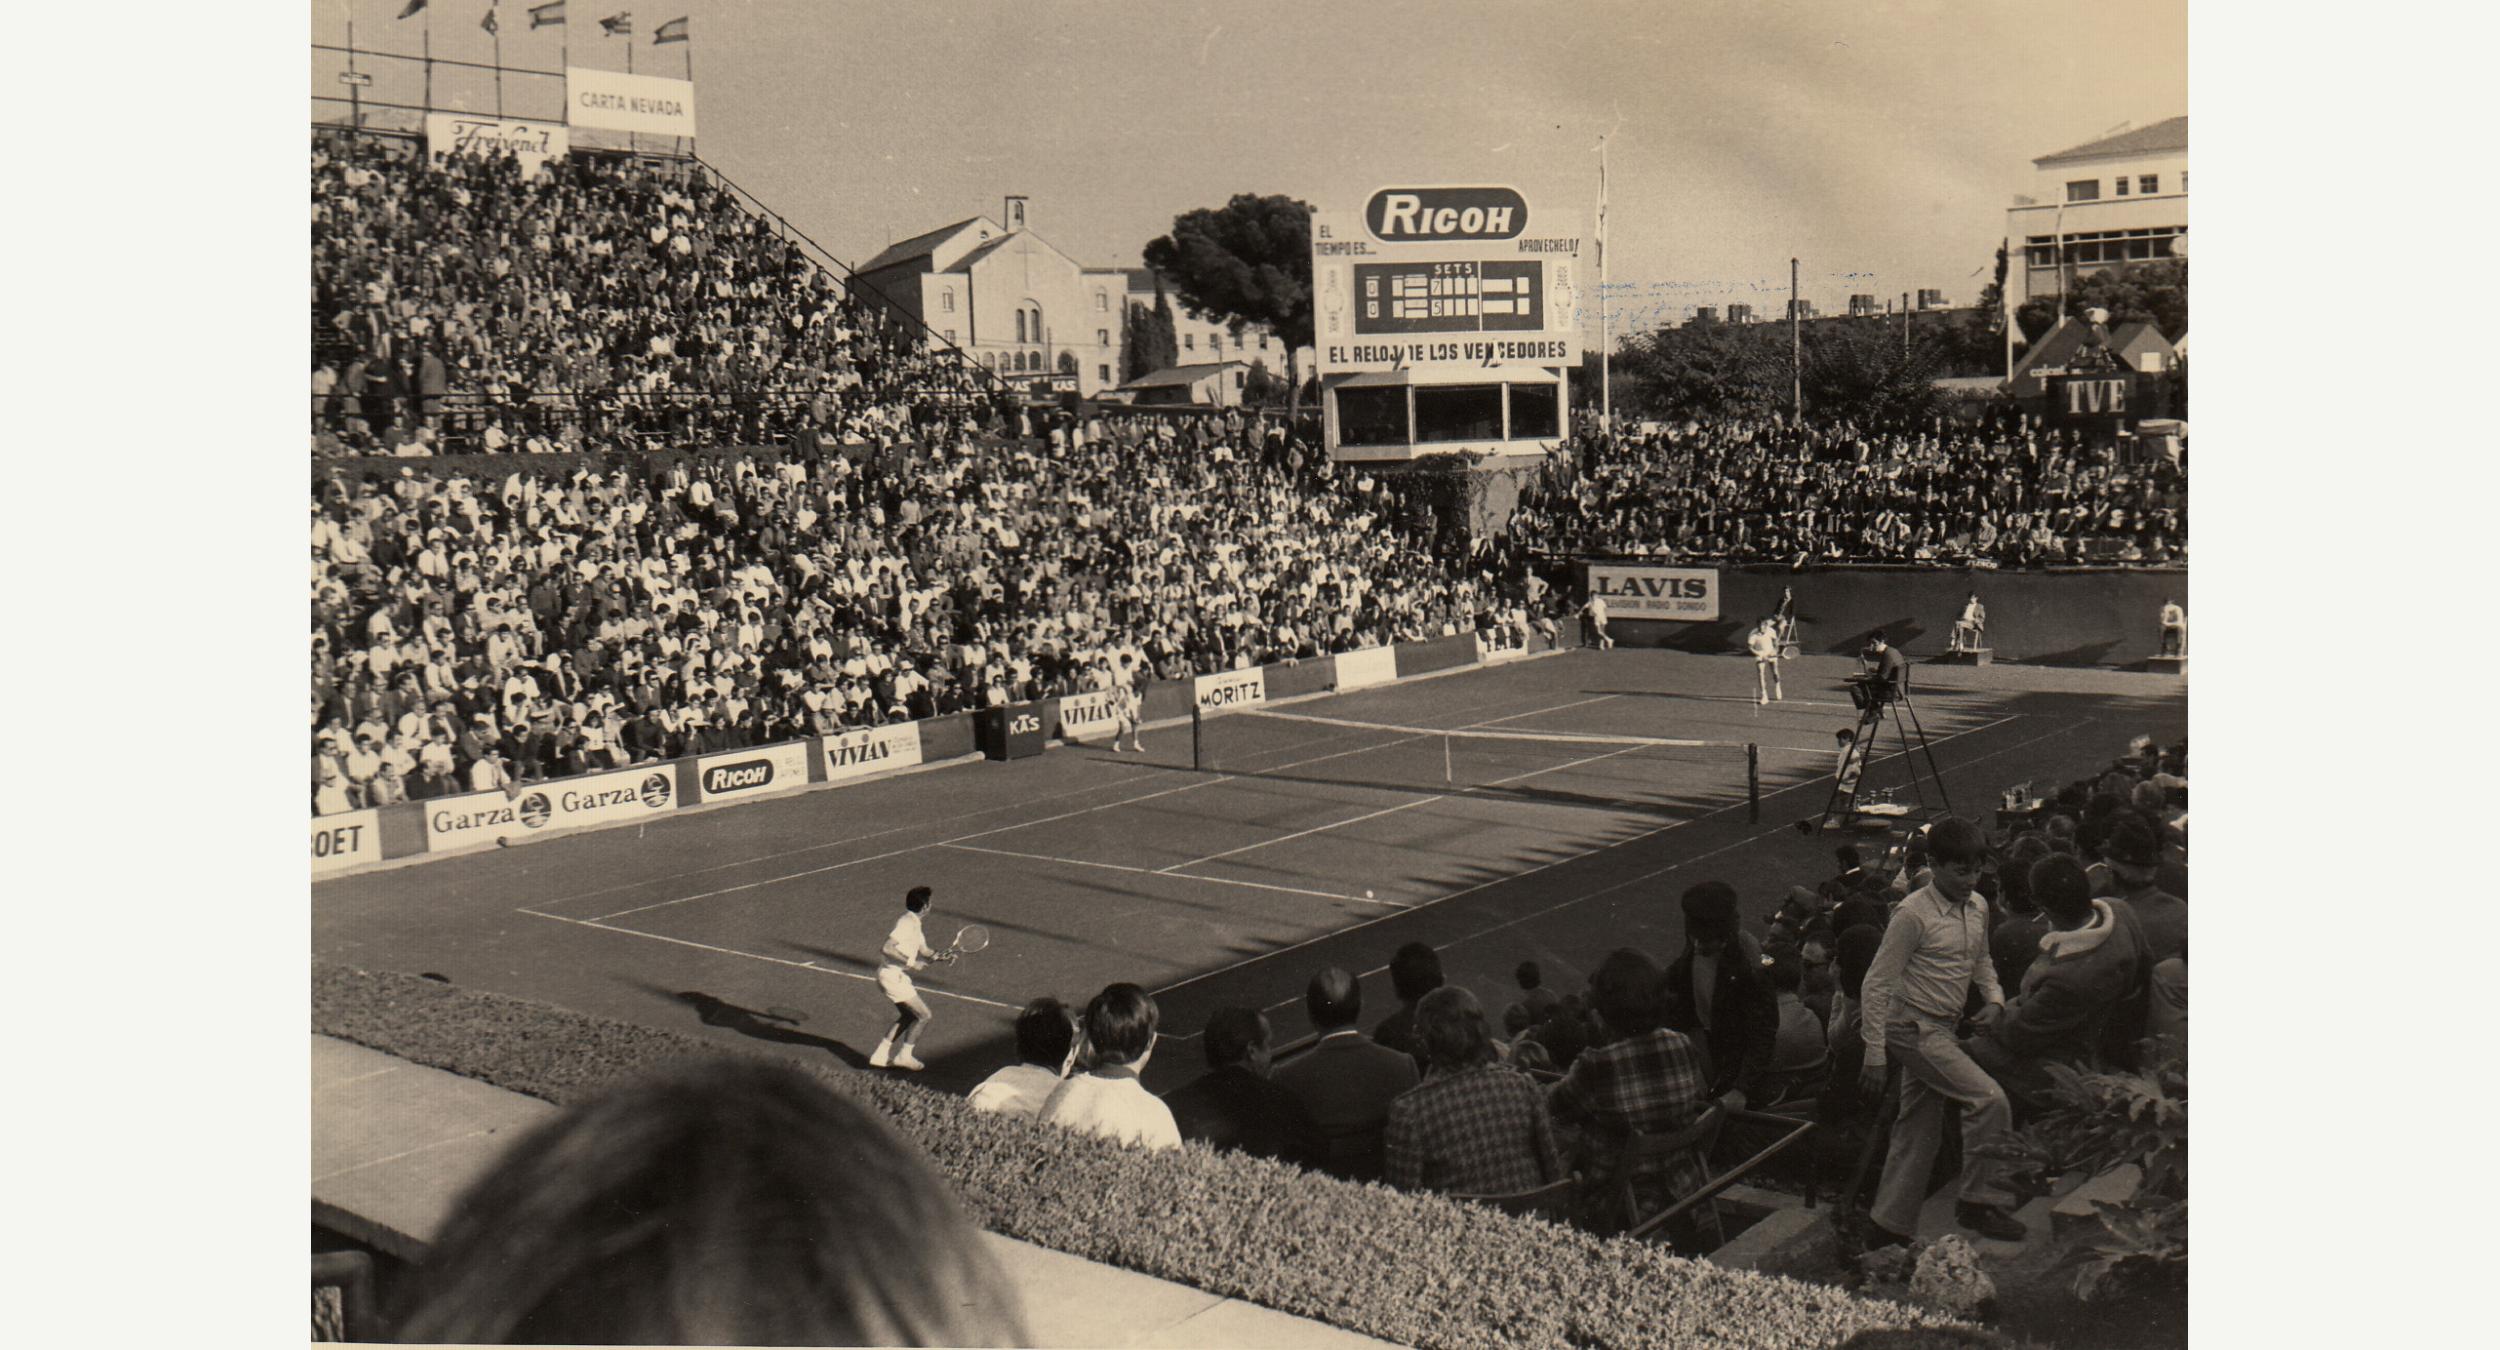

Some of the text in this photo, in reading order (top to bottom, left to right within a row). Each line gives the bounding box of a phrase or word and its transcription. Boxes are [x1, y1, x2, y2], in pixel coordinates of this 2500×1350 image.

[581, 92, 683, 116] CARTA NEVADA
[1380, 194, 1514, 234] RICOH
[1320, 225, 1333, 238] EL
[1315, 242, 1351, 256] TIEMPO
[1435, 264, 1472, 274] SETS
[1433, 281, 1440, 293] 7
[1433, 303, 1442, 315] 5
[1329, 345, 1348, 363] EL
[1353, 345, 1398, 362] RELOJ
[1429, 343, 1457, 361] LOS
[1464, 340, 1566, 360] VENCEDORES
[1052, 380, 1076, 391] KAS
[2067, 379, 2126, 414] TVE
[1597, 576, 1707, 599] LAVIS
[1201, 682, 1261, 707] MORITZ
[1009, 714, 1040, 735] KAS
[828, 734, 891, 768] VIVIAN
[711, 767, 767, 790] RICOH
[433, 787, 637, 833] Garza Garza
[311, 825, 363, 857] OET
